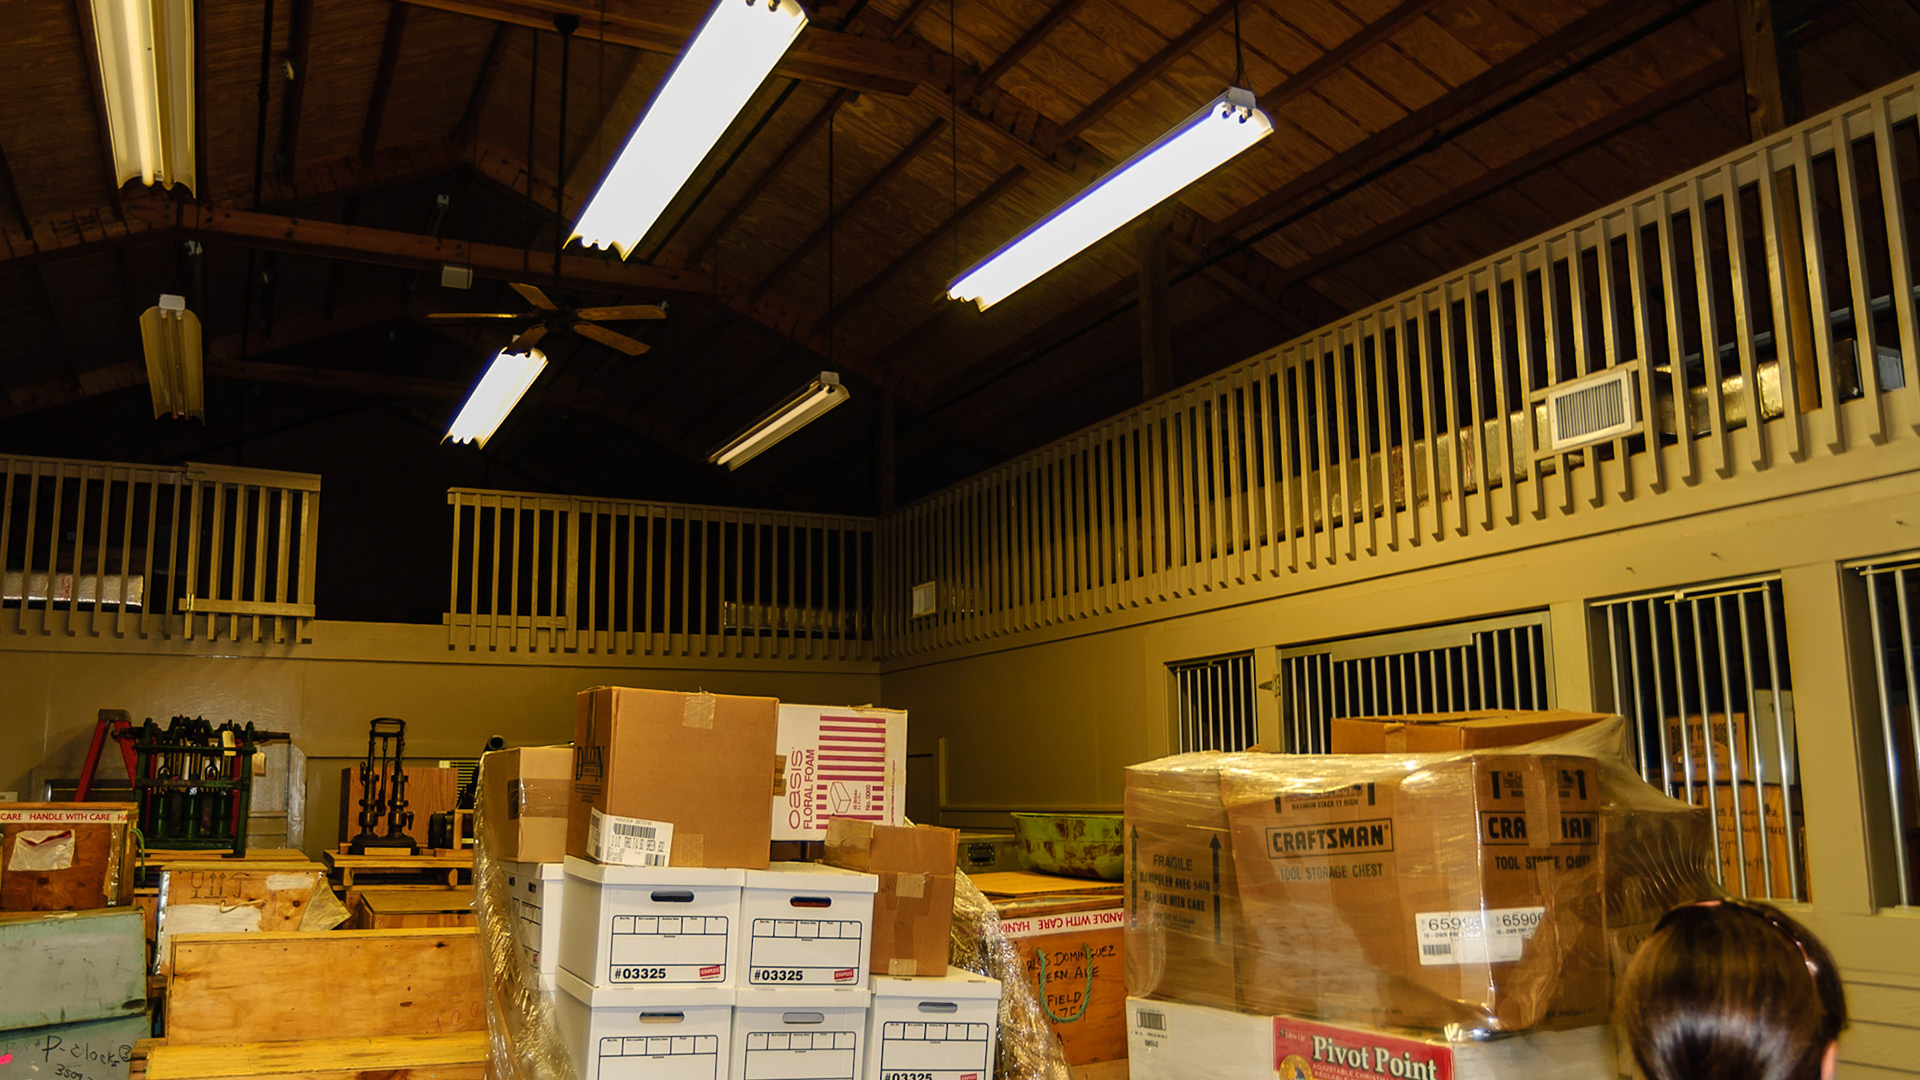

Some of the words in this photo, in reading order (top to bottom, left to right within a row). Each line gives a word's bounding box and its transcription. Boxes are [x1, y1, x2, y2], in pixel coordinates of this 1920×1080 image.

[804, 749, 815, 782] FOAM
[803, 784, 816, 830] FLORAL
[1317, 800, 1334, 809] STACK
[29, 813, 63, 821] HANDLE
[66, 813, 88, 821] WITH
[89, 813, 111, 821] CARE
[1272, 825, 1384, 853] CRAFTSMAN
[1153, 854, 1193, 872] FRAGILE
[1494, 856, 1521, 870] TOOL
[1279, 867, 1302, 881] TOOL
[1306, 865, 1347, 880] STORAGE
[1352, 863, 1383, 877] CHEST
[1175, 877, 1191, 890] AVEC
[1169, 895, 1185, 909] WITH
[1187, 898, 1205, 912] CARE
[1038, 917, 1063, 930] CARE
[1066, 915, 1091, 928] WITH
[1093, 911, 1124, 924] ANDLE
[614, 967, 667, 980] #03325
[754, 969, 804, 982] #03325
[1047, 991, 1082, 1007] FIELD
[1312, 1034, 1370, 1071] Pivot
[1374, 1046, 1437, 1080] Point
[1312, 1063, 1354, 1077] ADJUSTABLE
